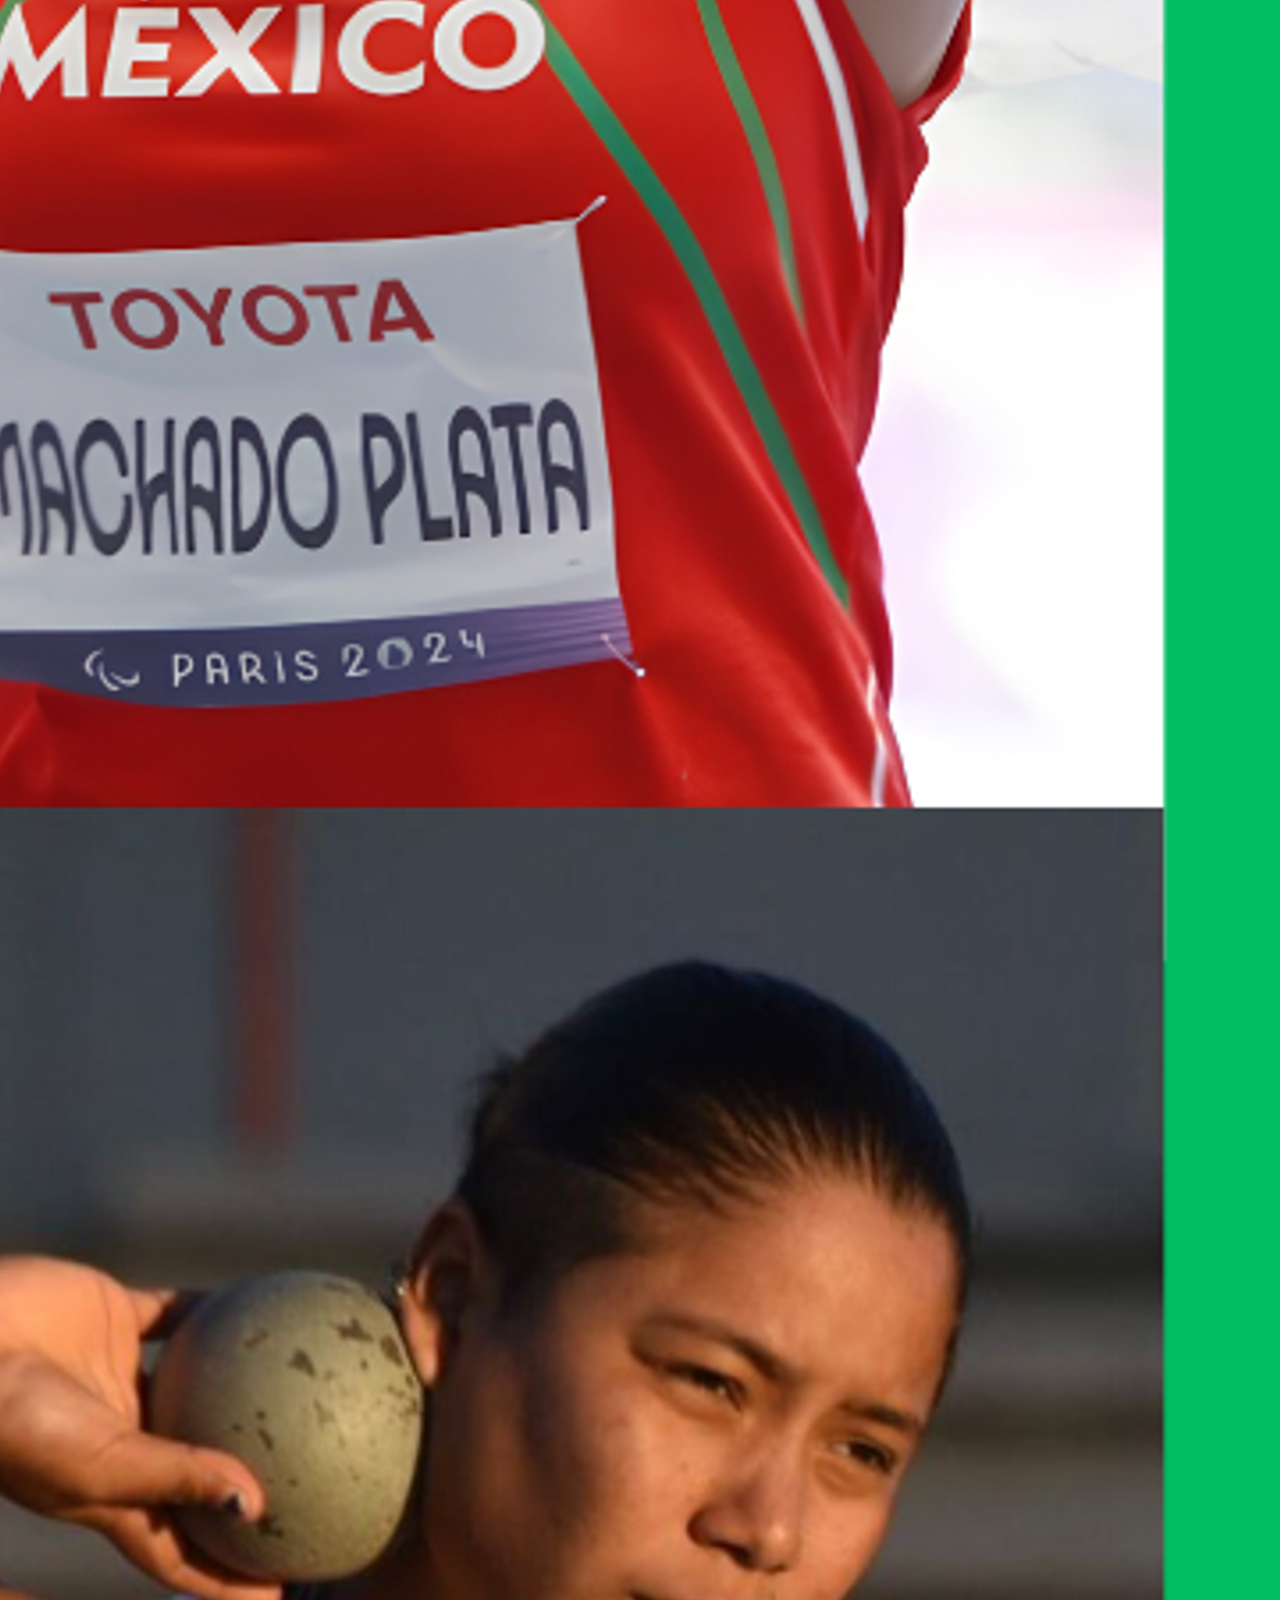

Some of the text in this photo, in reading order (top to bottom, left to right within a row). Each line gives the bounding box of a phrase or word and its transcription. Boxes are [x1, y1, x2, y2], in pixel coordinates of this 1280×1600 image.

[47, 278, 435, 350] TOYOTA
[359, 397, 590, 545] PLATA
[171, 628, 486, 688] PARIS 2024
